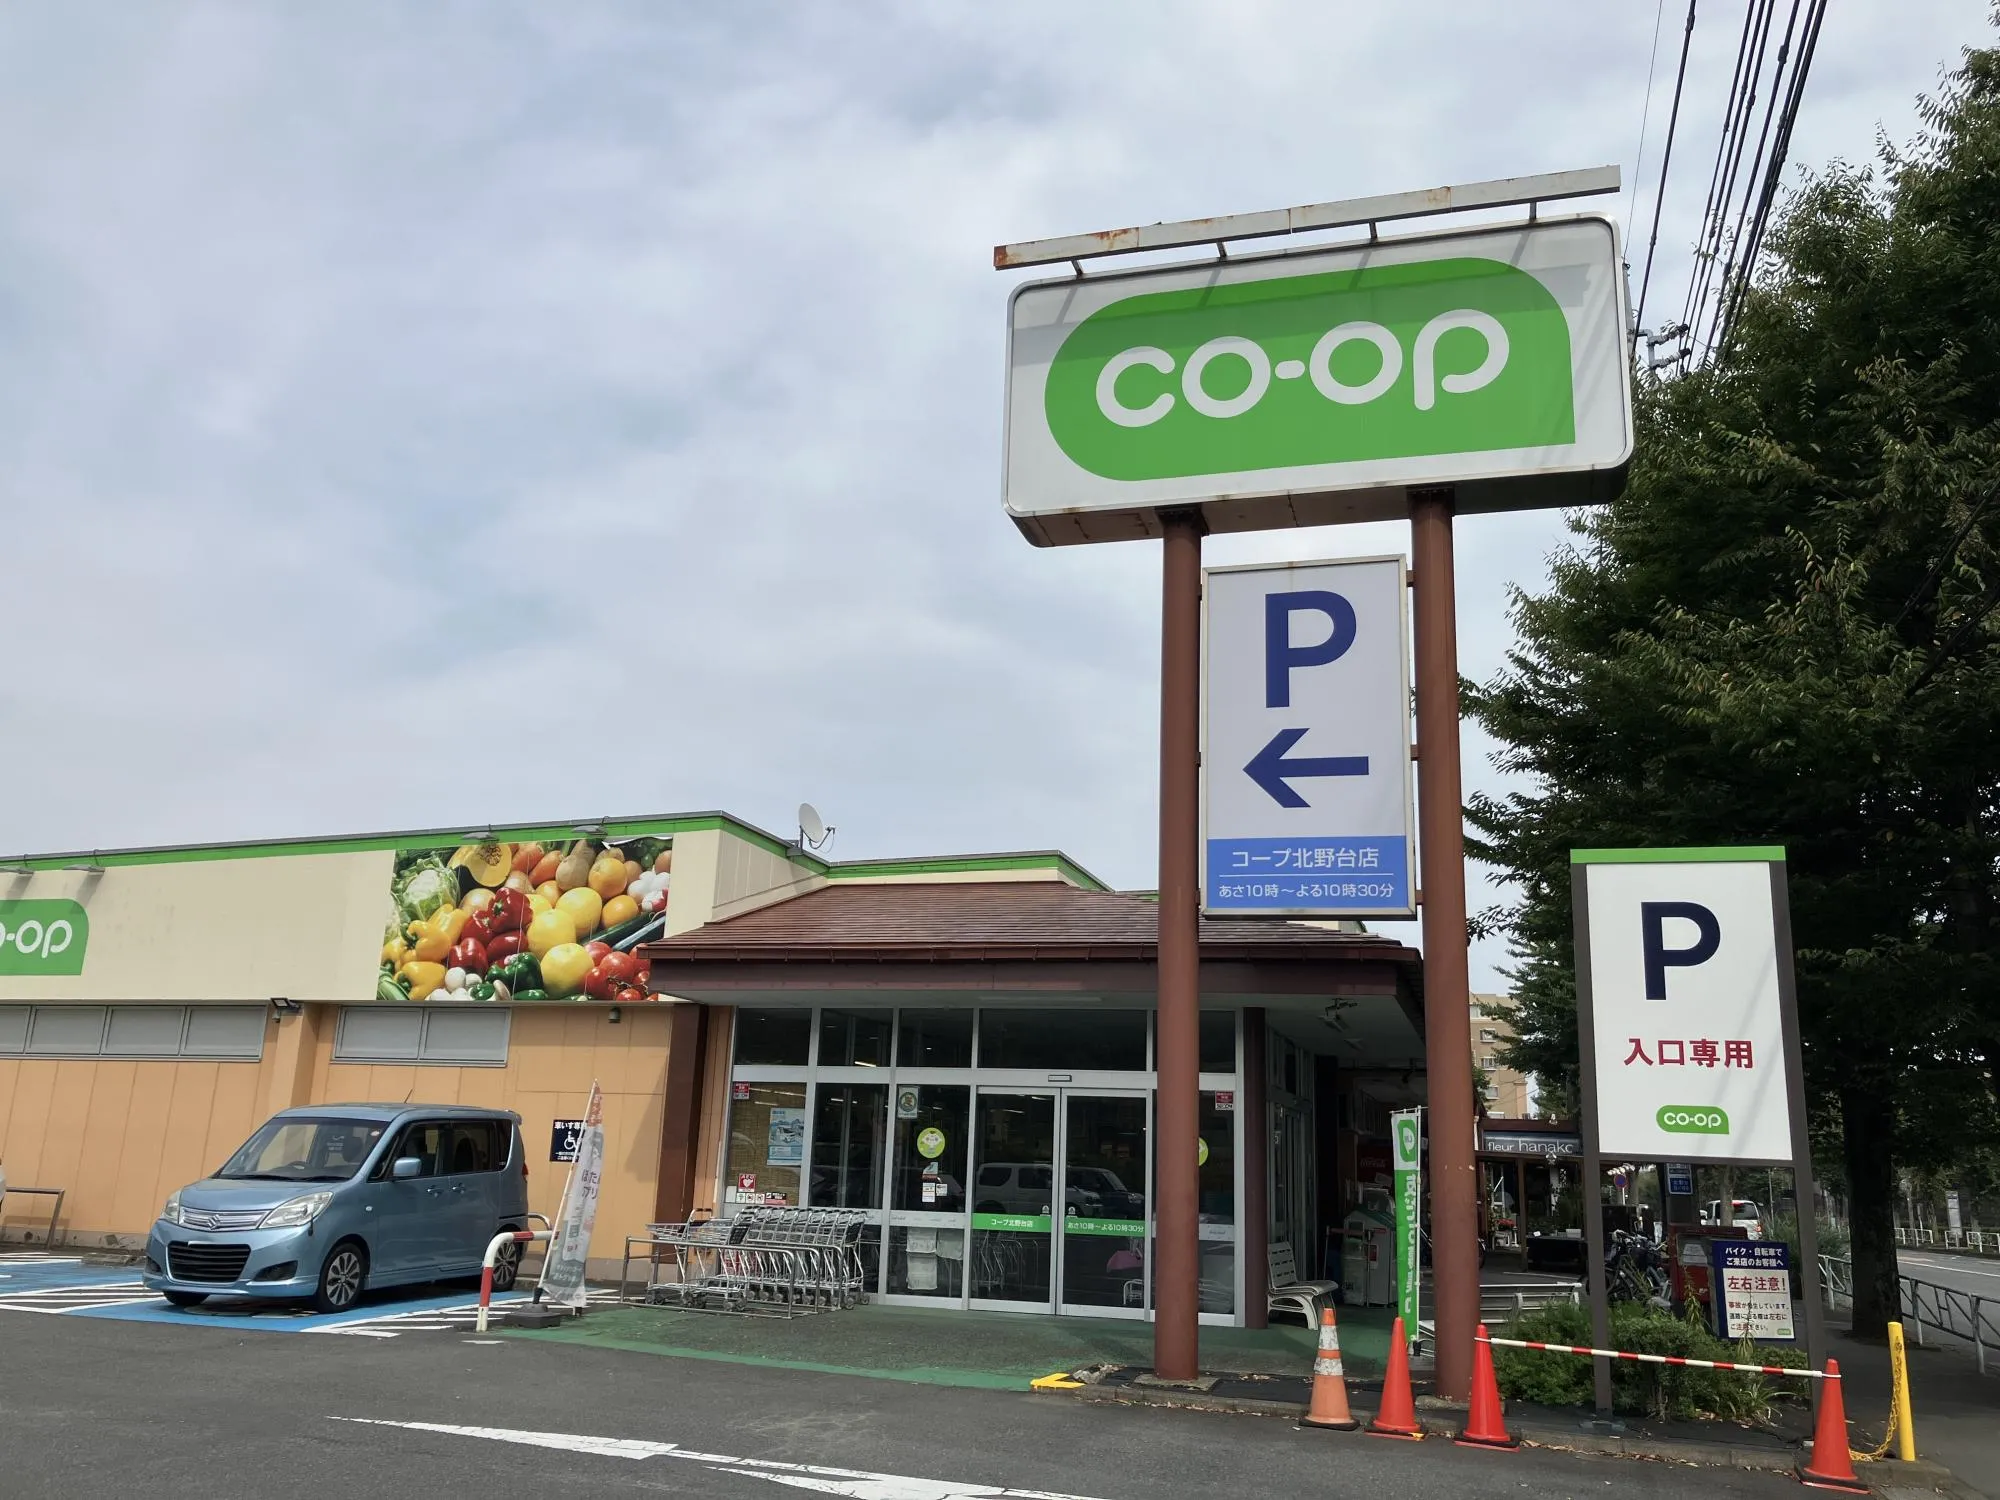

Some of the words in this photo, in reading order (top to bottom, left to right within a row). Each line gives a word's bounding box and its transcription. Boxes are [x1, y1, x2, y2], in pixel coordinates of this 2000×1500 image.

[1096, 308, 1510, 428] co-op
[1265, 590, 1357, 708] P
[1231, 847, 1379, 869] コープ北野台店
[0, 919, 73, 959] -op
[1640, 901, 1721, 1001] P
[1623, 1038, 1754, 1069] 入口専用
[1663, 1112, 1722, 1129] co-op
[1487, 1141, 1515, 1152] fleur
[1726, 1257, 1784, 1267] ご来店のお客様へ
